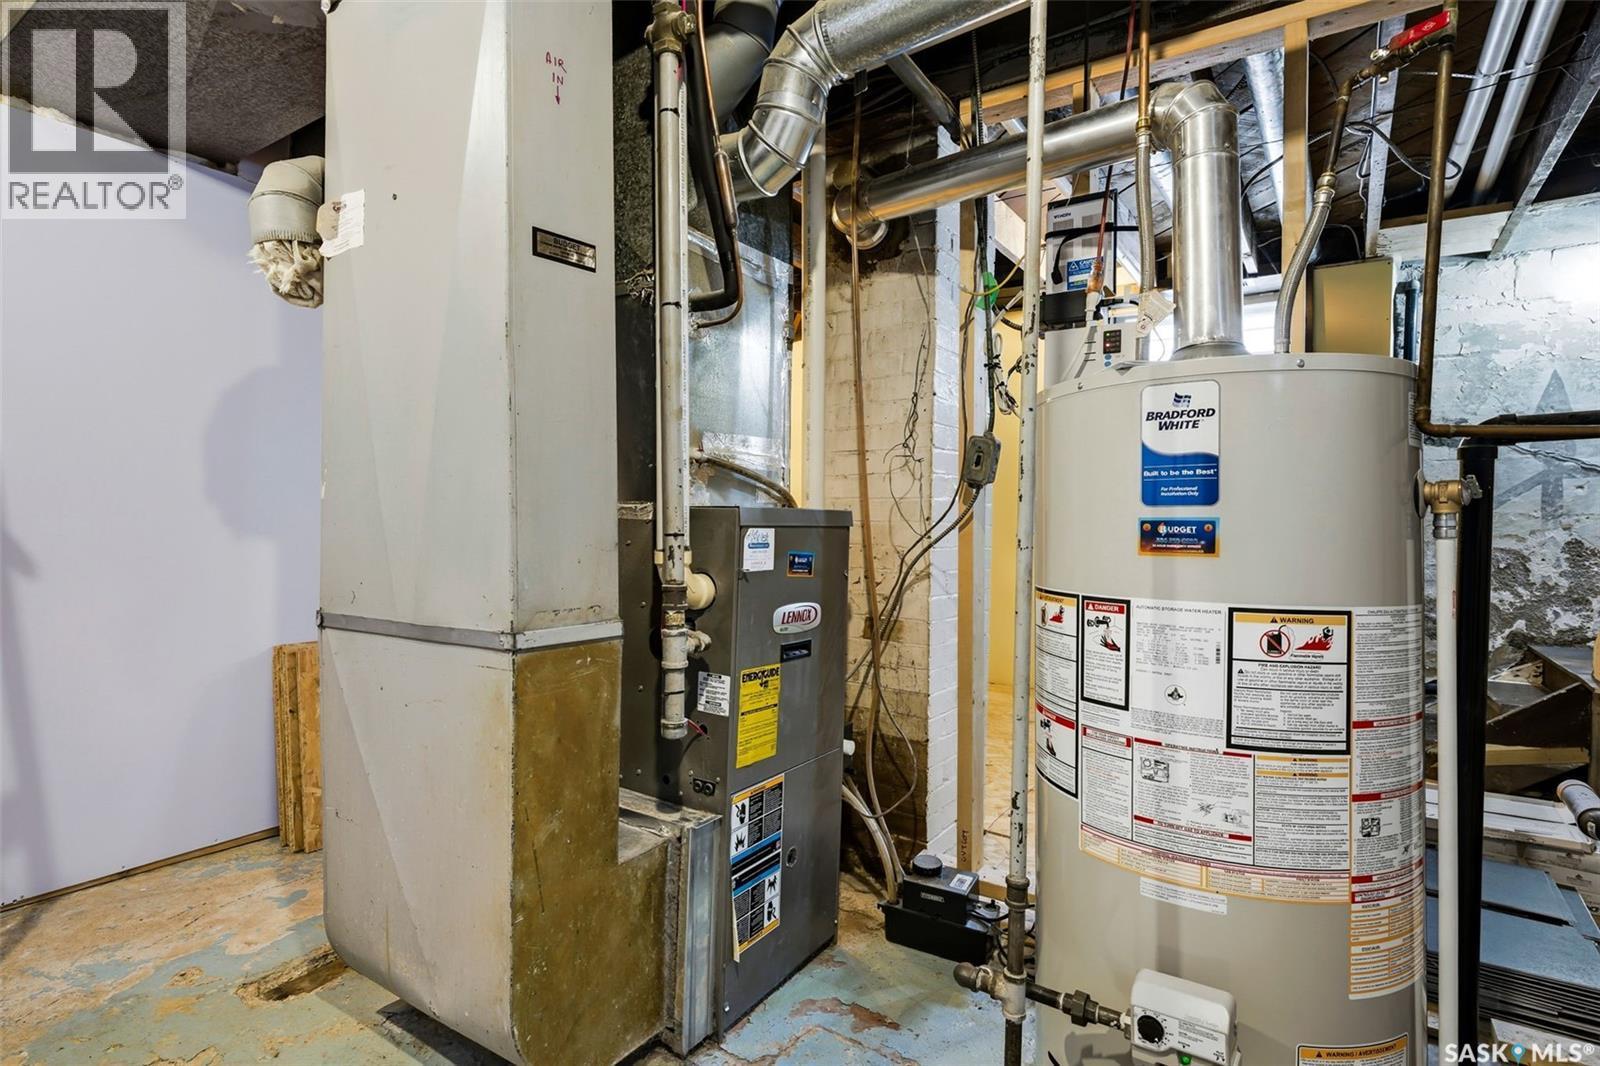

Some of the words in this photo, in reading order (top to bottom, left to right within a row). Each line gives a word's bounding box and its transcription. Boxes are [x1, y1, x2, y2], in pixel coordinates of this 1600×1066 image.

[545, 52, 567, 73] AIR
[552, 73, 564, 85] IN
[1145, 408, 1216, 422] BRADFORD
[1158, 419, 1200, 431] WHITE
[1157, 523, 1197, 535] BUDGET
[1094, 604, 1120, 612] DANGER
[781, 609, 813, 625] LENNOX
